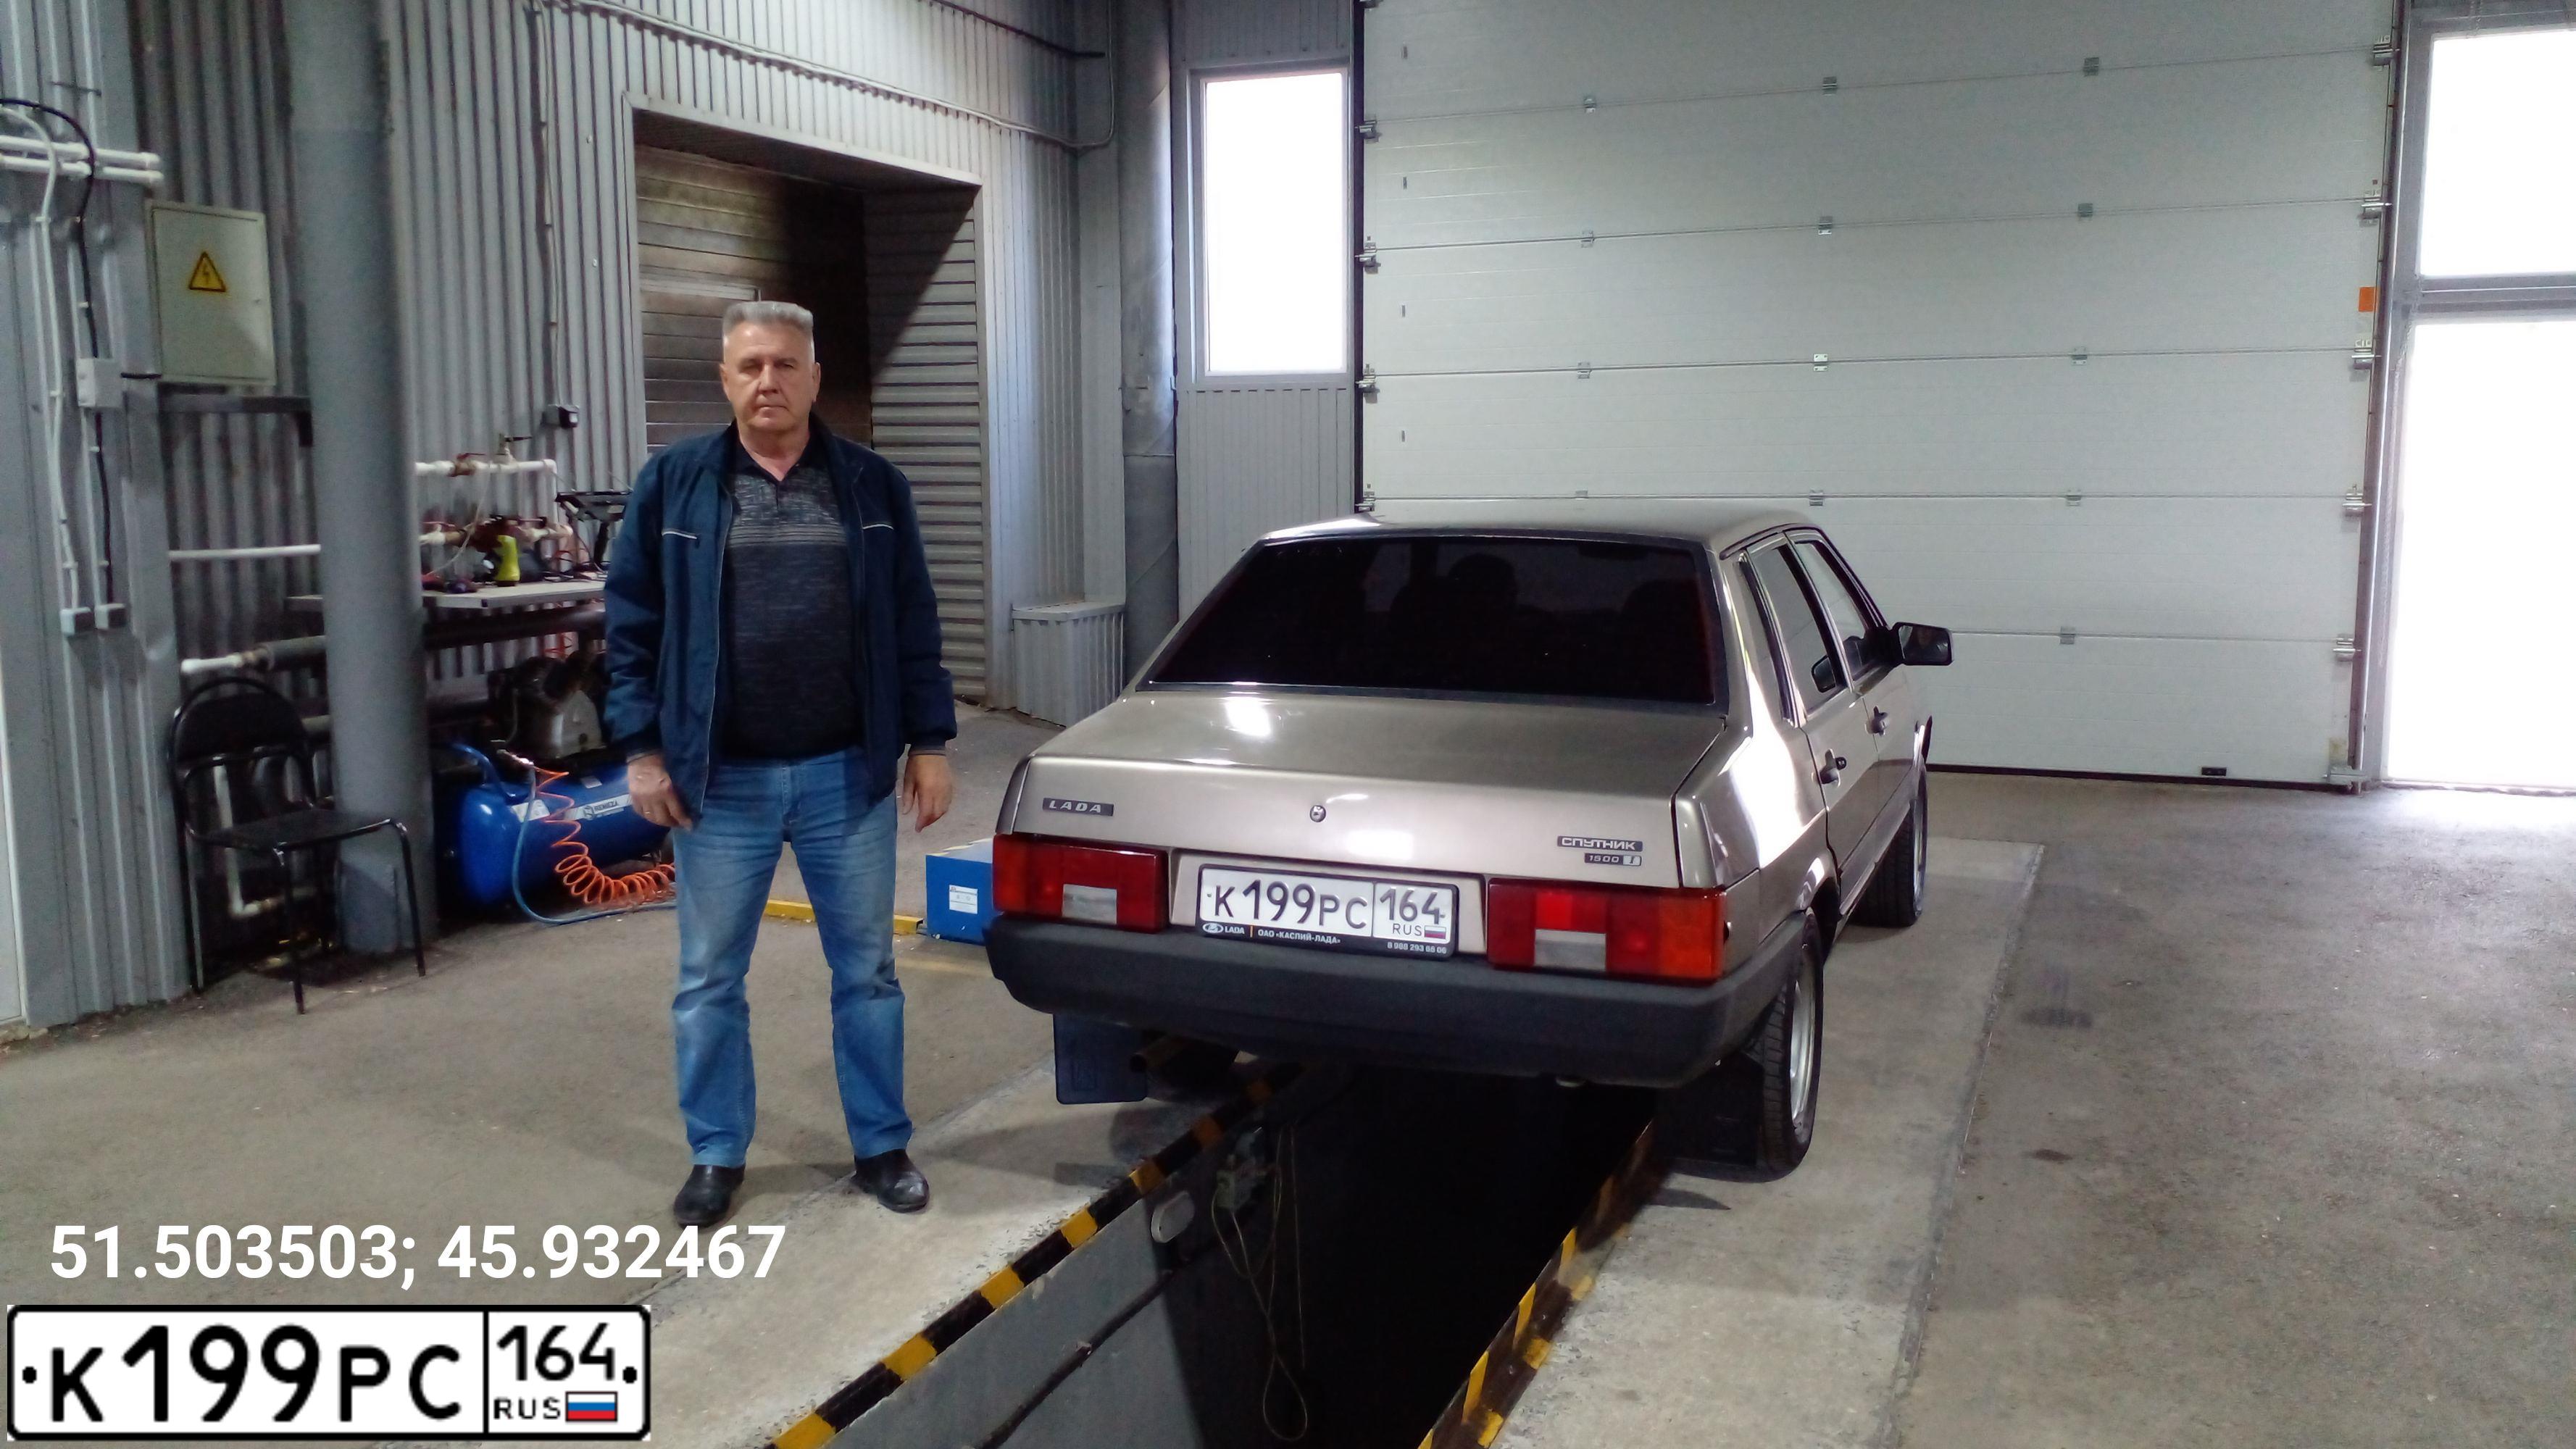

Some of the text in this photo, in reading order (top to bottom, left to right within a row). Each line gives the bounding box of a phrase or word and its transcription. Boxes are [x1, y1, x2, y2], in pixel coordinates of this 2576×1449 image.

[1049, 799, 1101, 814] LADA
[1561, 837, 1636, 851] СПУТНИК
[1589, 855, 1620, 864] 1500
[1379, 885, 1441, 925] 164
[1224, 925, 1246, 935] LADA
[1257, 928, 1275, 938] ОАО
[1391, 922, 1422, 937] RUS
